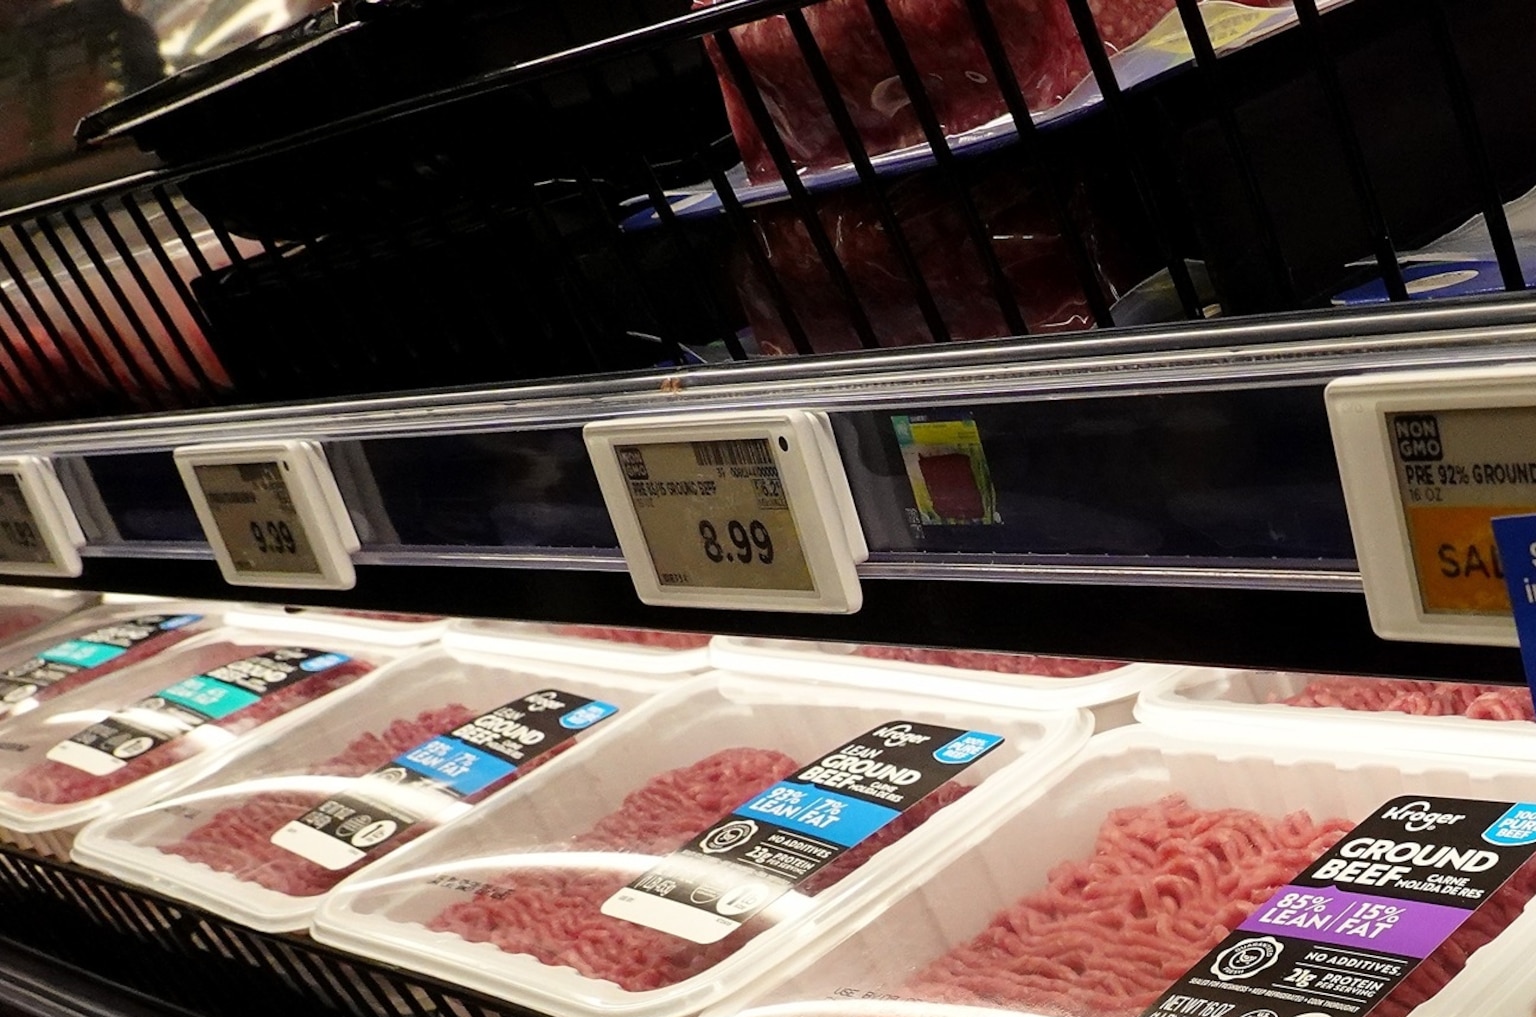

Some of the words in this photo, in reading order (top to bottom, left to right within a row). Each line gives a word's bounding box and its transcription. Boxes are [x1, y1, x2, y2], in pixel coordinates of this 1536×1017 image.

[1397, 420, 1436, 438] NON
[1402, 439, 1441, 457] GMO
[1406, 465, 1434, 485] PRE
[1438, 463, 1470, 485] 92%
[699, 518, 774, 565] 8.99
[1438, 542, 1504, 581] SAL
[450, 723, 500, 745] BEEF
[473, 714, 546, 746] GROUND
[871, 723, 932, 747] Kroger
[839, 743, 884, 759] LEAN
[405, 750, 442, 770] LEAN
[438, 760, 470, 778] FAT
[820, 753, 922, 786] GROUND
[797, 765, 864, 789] BEEF
[748, 797, 802, 818] LEAN
[797, 809, 841, 829] FAT
[766, 787, 809, 805] 93%
[815, 798, 849, 816] 7%
[1380, 800, 1467, 833] Kroger
[1495, 827, 1536, 840] BEEF
[745, 845, 774, 864] 23g
[772, 852, 816, 870] PROTEIN
[767, 834, 786, 844] NO
[783, 838, 833, 859] ADDITIVES
[1339, 837, 1500, 873] GROUND
[1311, 858, 1413, 887] BEEF
[1426, 873, 1471, 887] CARNE
[1397, 877, 1442, 894] MOLIDA
[1442, 885, 1459, 896] DE
[1458, 887, 1486, 900] RES
[1275, 892, 1333, 914] 85%
[1351, 902, 1407, 925] 15%
[1258, 906, 1332, 931] LEAN
[1335, 917, 1394, 940] FAT
[1304, 951, 1326, 964] NO
[1325, 954, 1398, 976] ADDITIVES
[1282, 967, 1317, 988] 21g
[1322, 972, 1385, 994] PROTEIN
[1314, 981, 1332, 991] PER
[1331, 984, 1377, 998] SERVING
[1159, 995, 1188, 1013] NET
